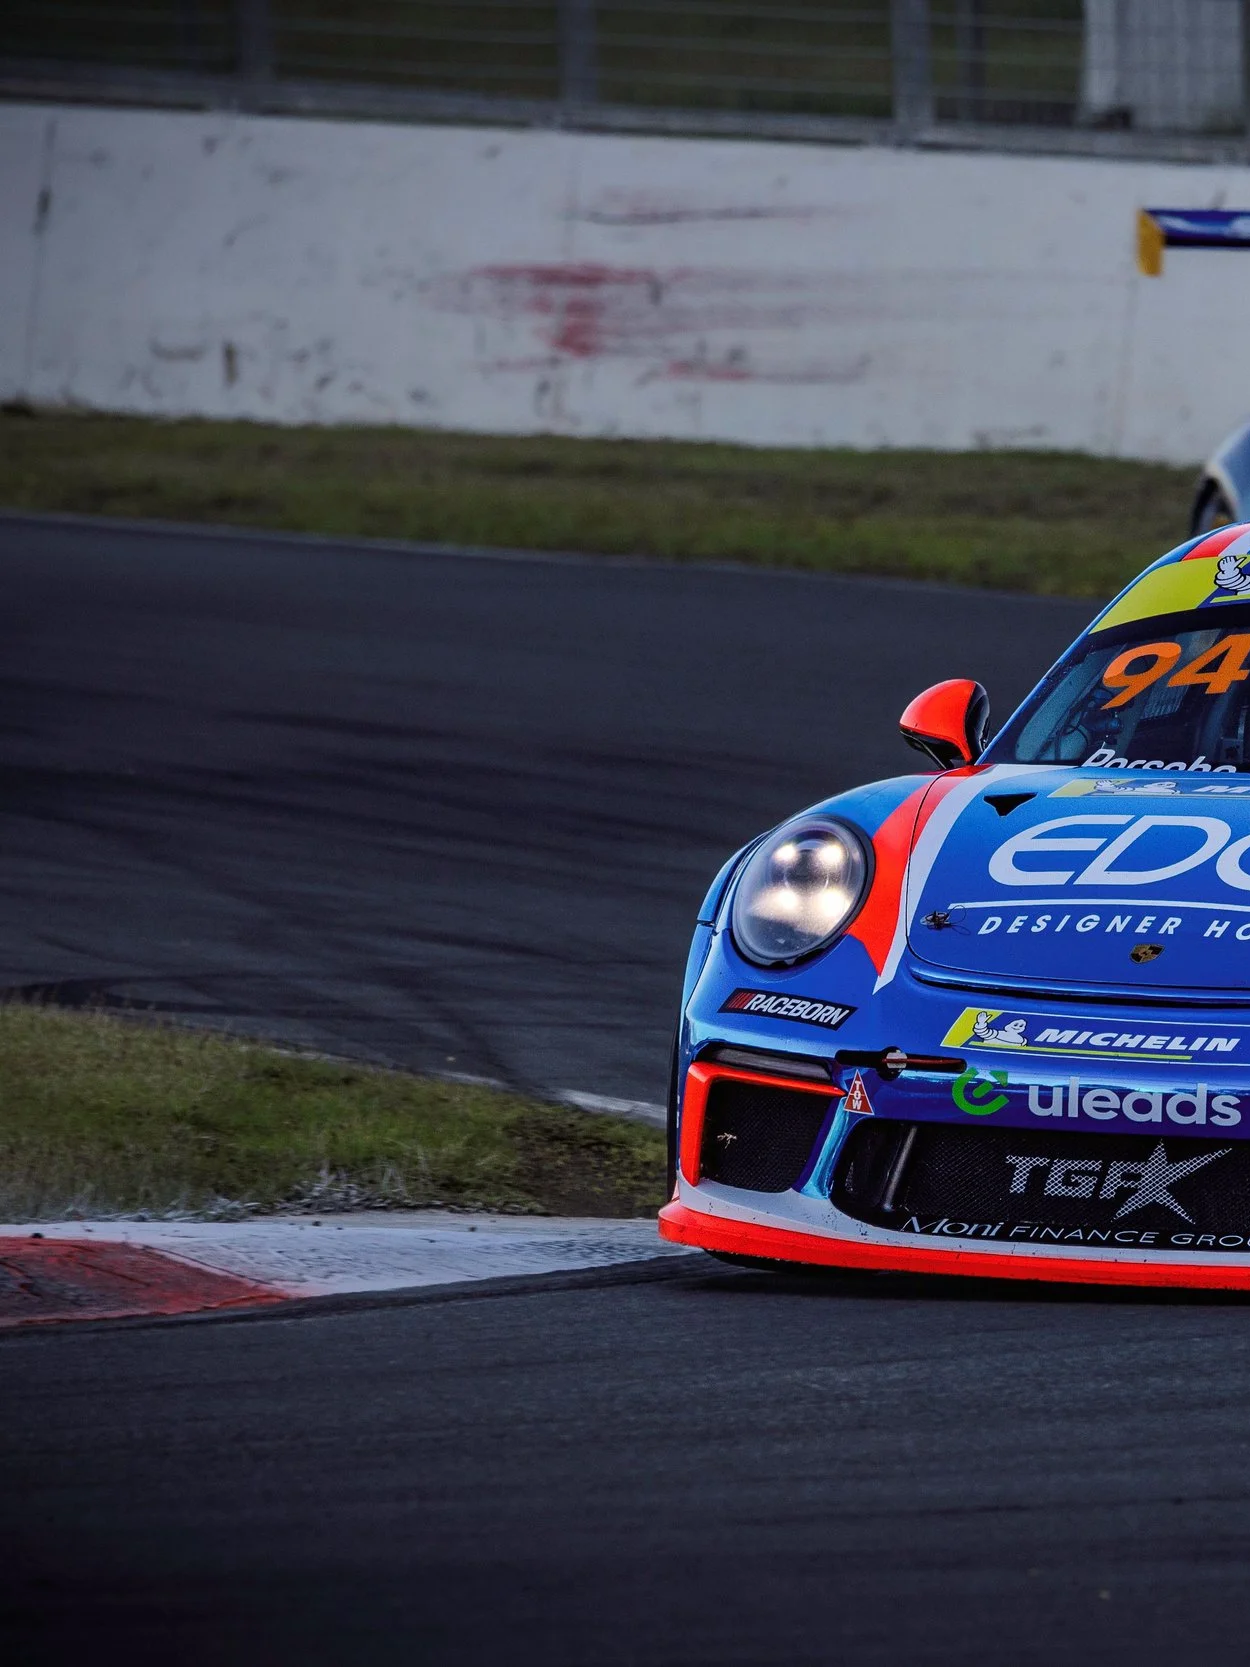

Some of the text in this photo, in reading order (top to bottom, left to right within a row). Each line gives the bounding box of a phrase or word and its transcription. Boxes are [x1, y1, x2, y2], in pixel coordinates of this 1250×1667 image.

[978, 915, 1180, 935] DESIGNER
[744, 994, 849, 1025] RACEBORN
[1034, 1027, 1241, 1052] MICHELIN
[852, 1080, 863, 1110] TOW
[1028, 1076, 1242, 1127] uleads
[1009, 1225, 1157, 1244] FINANCE
